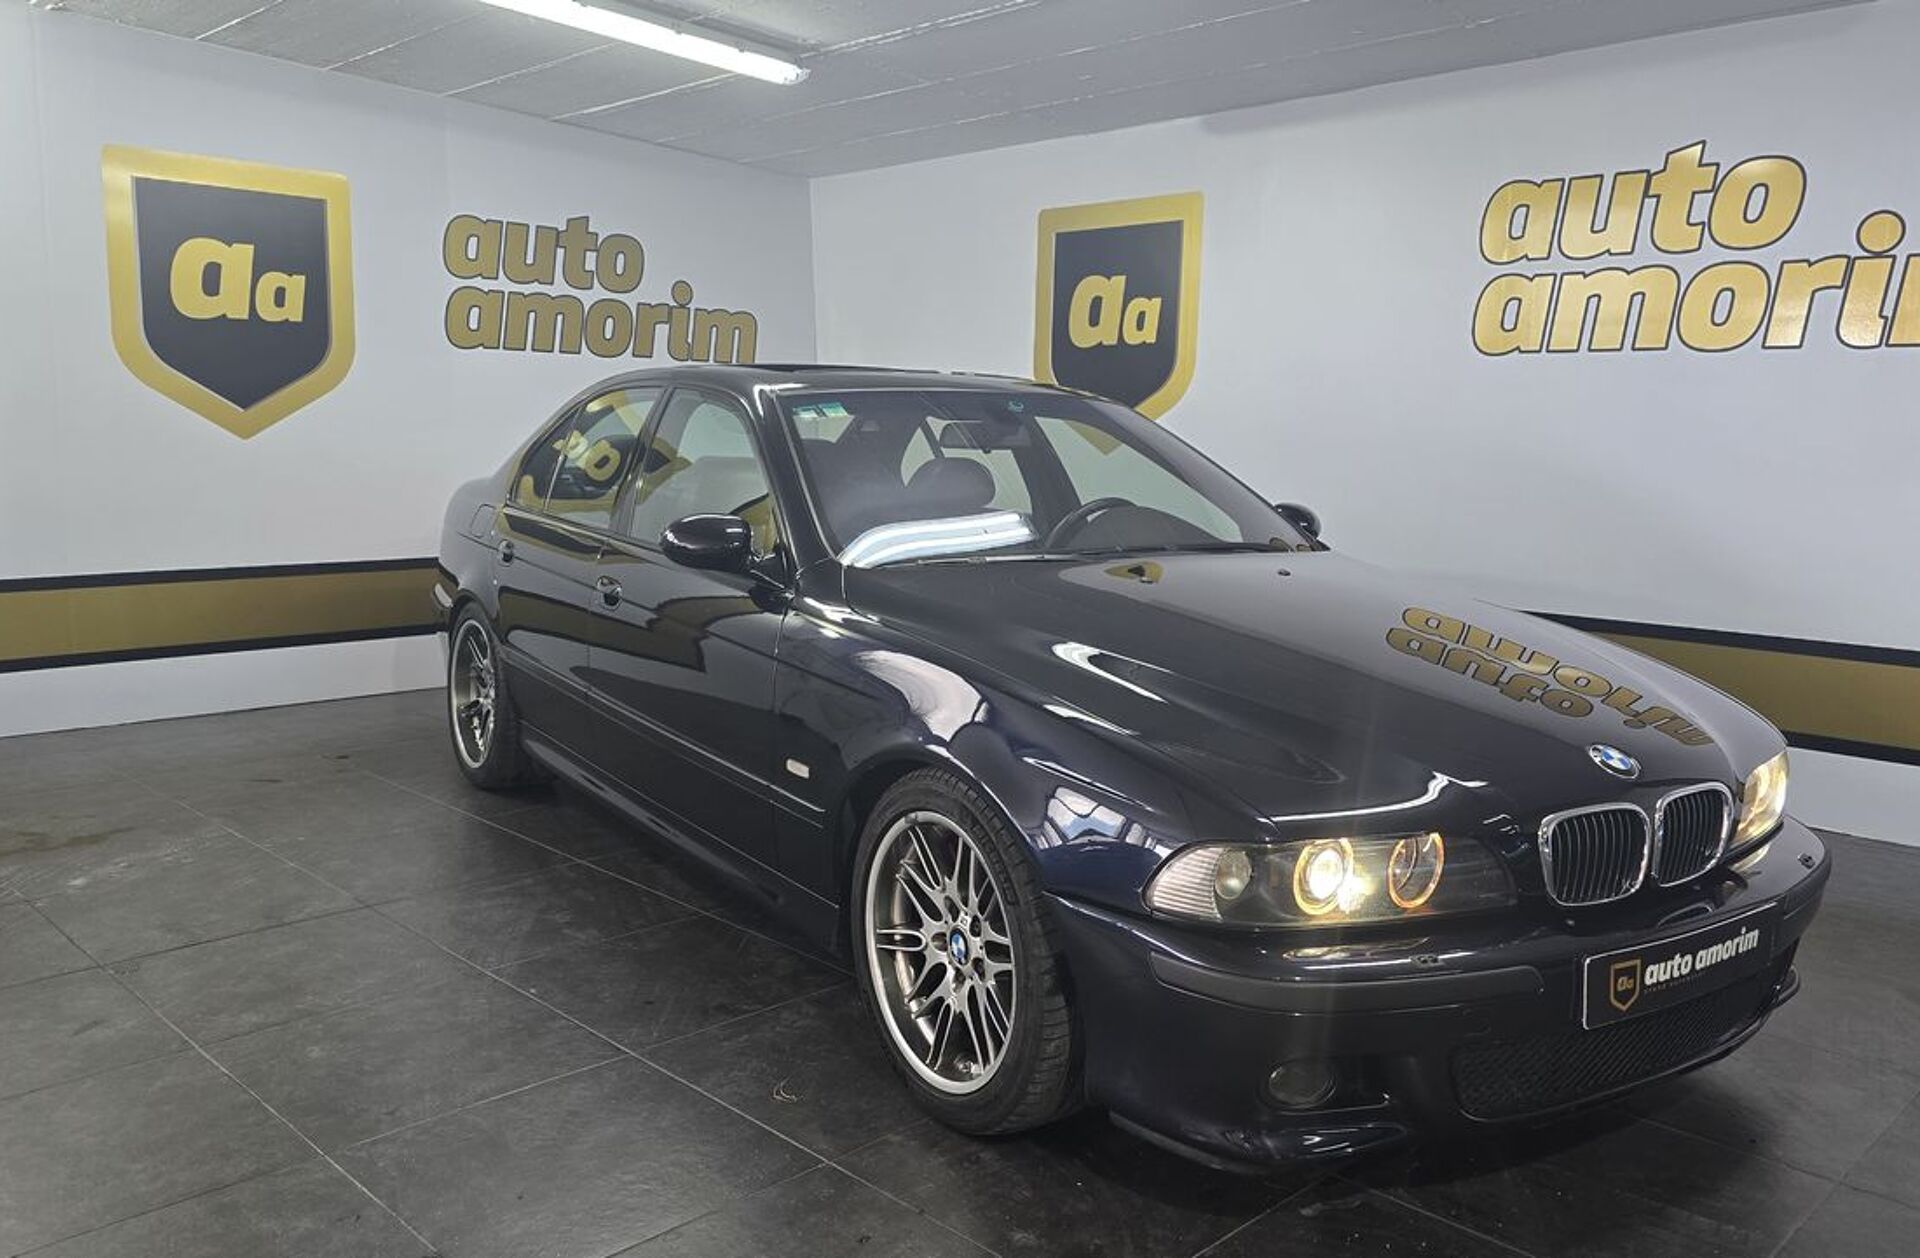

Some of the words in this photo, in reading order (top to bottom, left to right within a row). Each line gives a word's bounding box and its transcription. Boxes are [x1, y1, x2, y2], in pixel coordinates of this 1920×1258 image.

[1479, 139, 1807, 265] auto
[170, 236, 306, 323] aa
[443, 213, 645, 293] auto
[1471, 209, 1920, 357] amori
[445, 280, 758, 363] amorim
[1067, 271, 1162, 348] aa
[1644, 953, 1692, 985] auto
[1695, 927, 1759, 970] amorim
